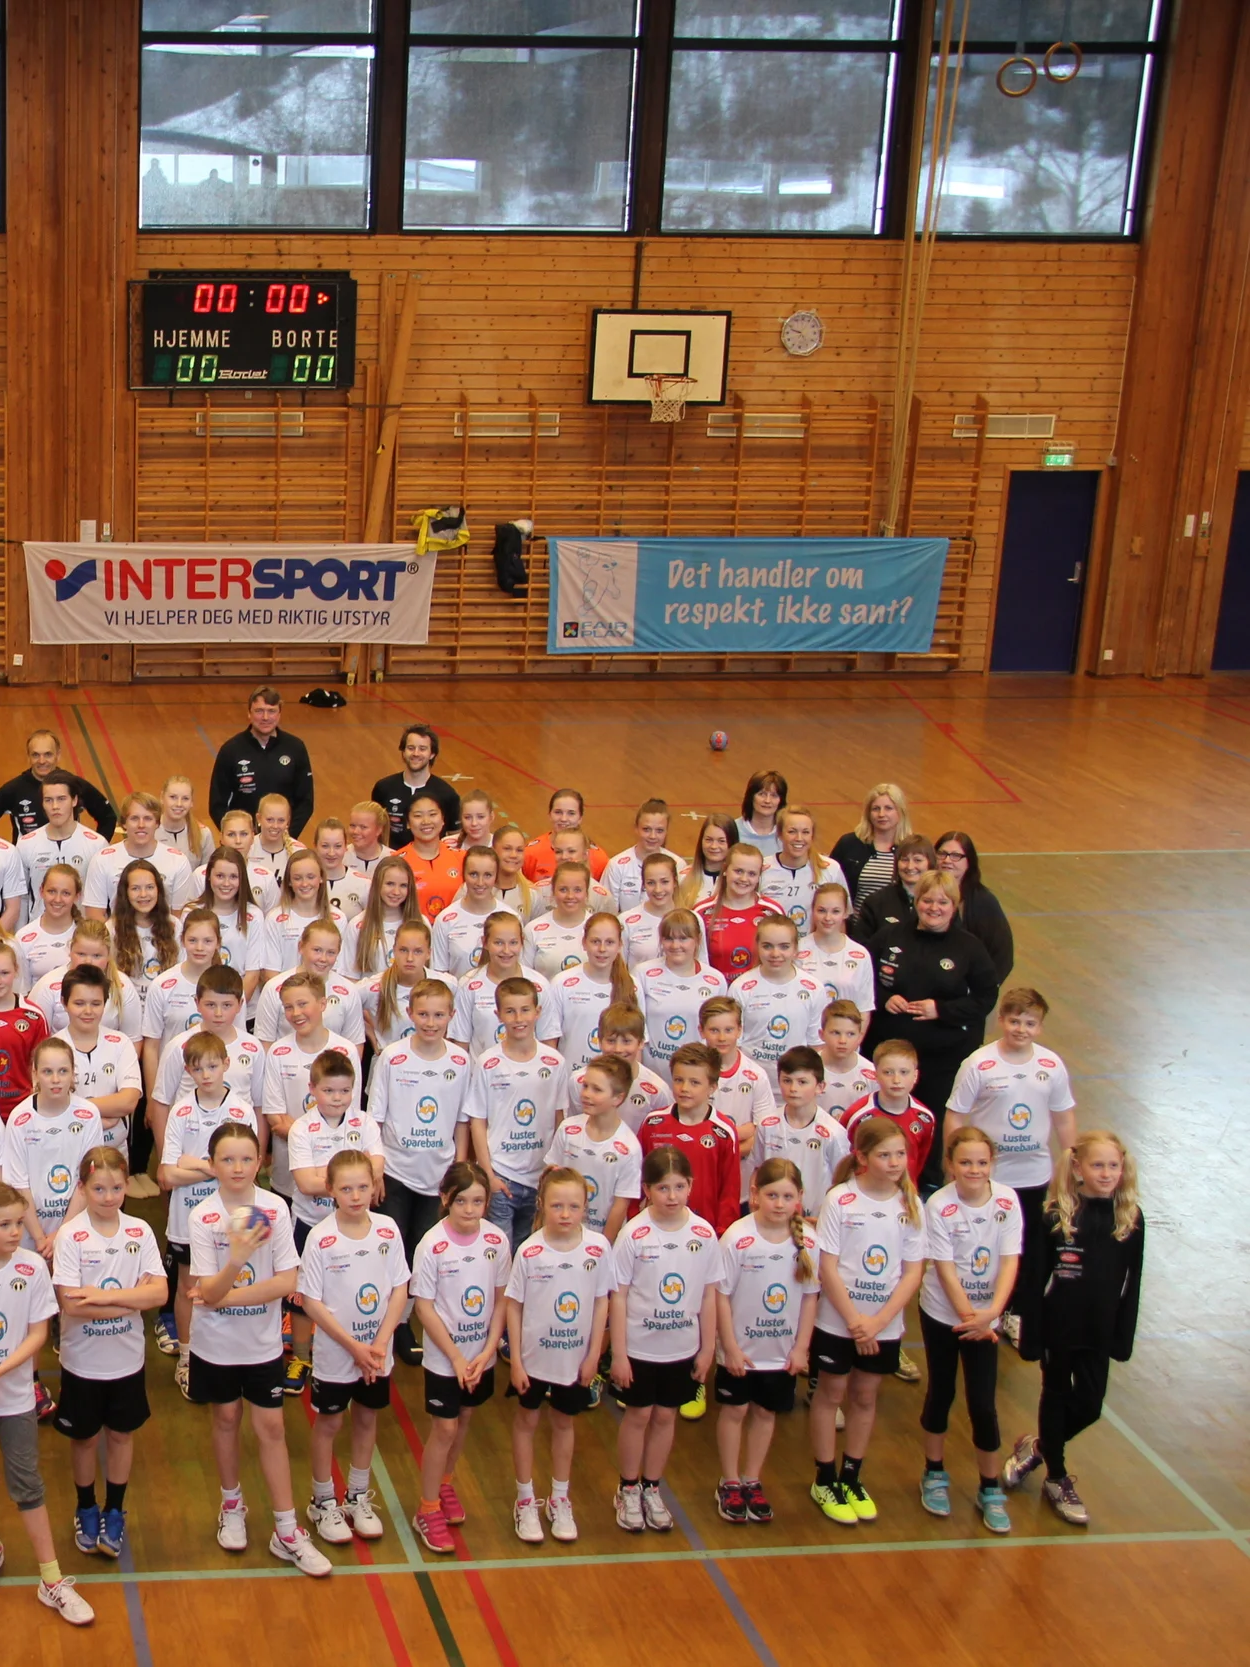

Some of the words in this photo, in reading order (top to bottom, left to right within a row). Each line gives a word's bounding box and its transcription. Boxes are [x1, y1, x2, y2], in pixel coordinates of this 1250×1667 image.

[153, 330, 231, 348] HJEMME
[272, 330, 338, 348] BORTE
[176, 354, 218, 382] 00
[292, 354, 334, 382] 00
[104, 557, 407, 601] INTERSPORT
[668, 559, 711, 588] Det
[718, 557, 818, 589] handler
[826, 566, 864, 589] om
[105, 611, 119, 625] VI
[125, 611, 198, 626] HJELPER
[203, 610, 233, 625] DEG
[239, 610, 273, 625] MED
[278, 610, 327, 625] RIKTIG
[332, 610, 390, 626] UTSTYR
[664, 596, 768, 630] respekt,
[777, 596, 831, 623] ikke
[839, 596, 913, 625] sant?
[581, 621, 628, 630] FAIR
[581, 629, 628, 638] PLAY
[787, 887, 800, 897] 27
[84, 1072, 96, 1085] 24
[411, 1127, 437, 1137] Luster
[510, 1130, 536, 1139] Luster
[1003, 1134, 1031, 1142] Luster
[401, 1137, 444, 1148] Sparebank
[501, 1139, 543, 1151] Sparebank
[44, 1199, 68, 1208] Luste
[855, 1278, 886, 1290] Luster
[848, 1289, 890, 1302] pareban
[654, 1309, 685, 1319] Luster
[458, 1321, 485, 1332] Luster
[643, 1318, 693, 1331] Sparebank
[756, 1317, 785, 1327] Luster
[83, 1320, 133, 1337] Sparebank
[550, 1328, 578, 1337] Luster
